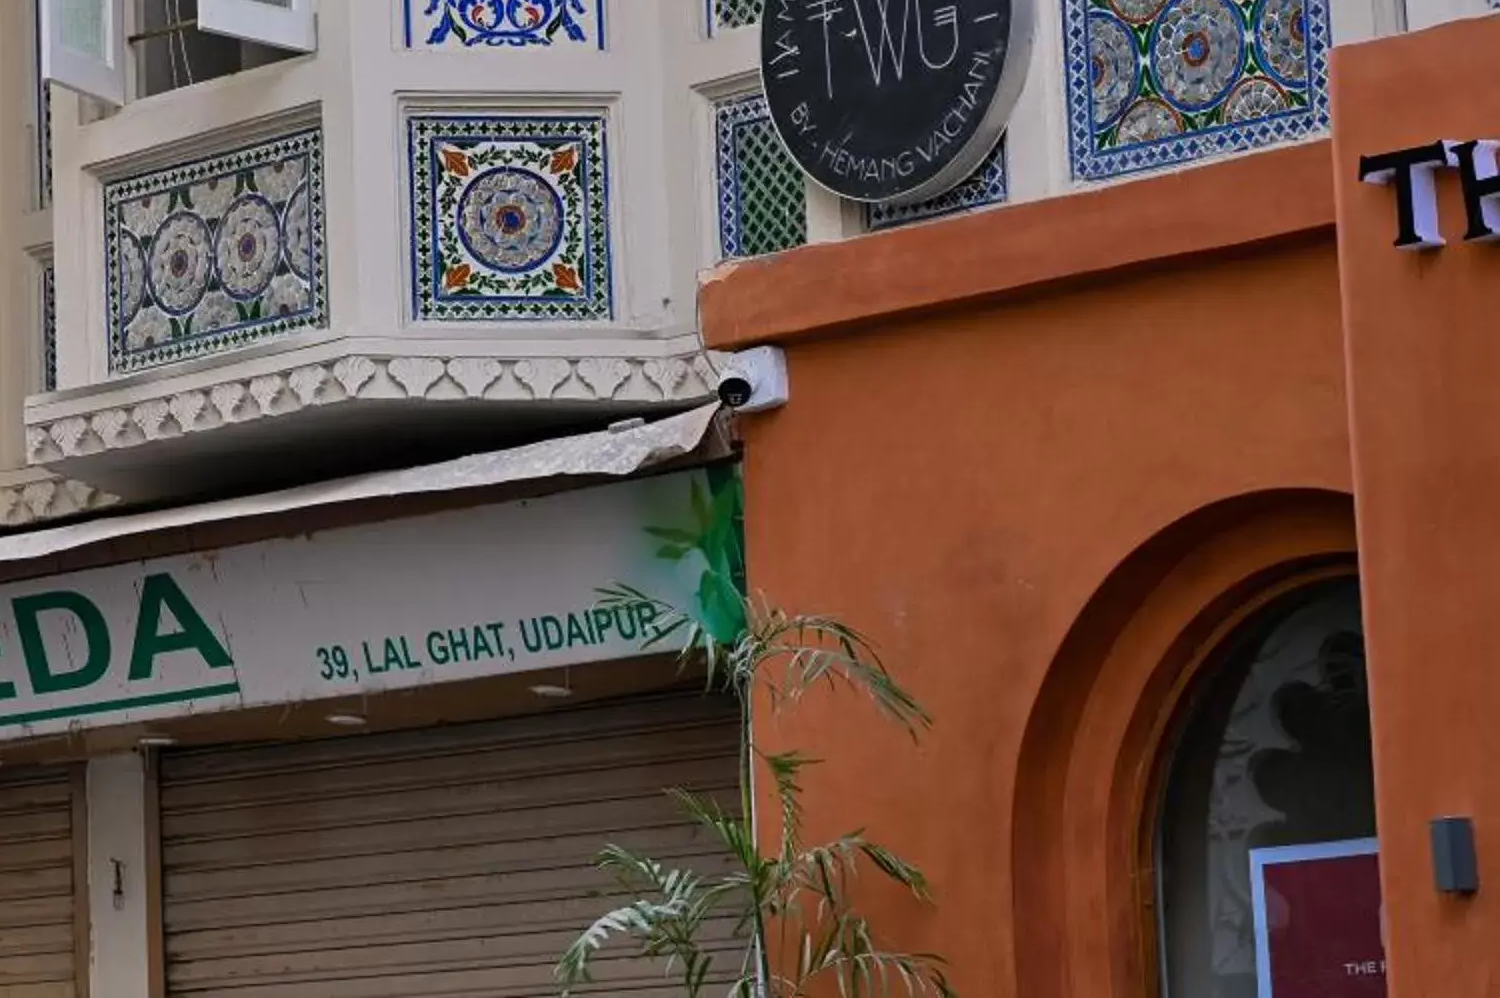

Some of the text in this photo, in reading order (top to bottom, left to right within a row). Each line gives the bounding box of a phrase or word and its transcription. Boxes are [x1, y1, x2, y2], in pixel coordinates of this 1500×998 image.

[818, 141, 915, 183] HEMANG
[916, 51, 992, 162] VACHANI
[316, 602, 658, 682] 39, LAL GHAT, UDAIPUR
[1342, 961, 1377, 975] THE
